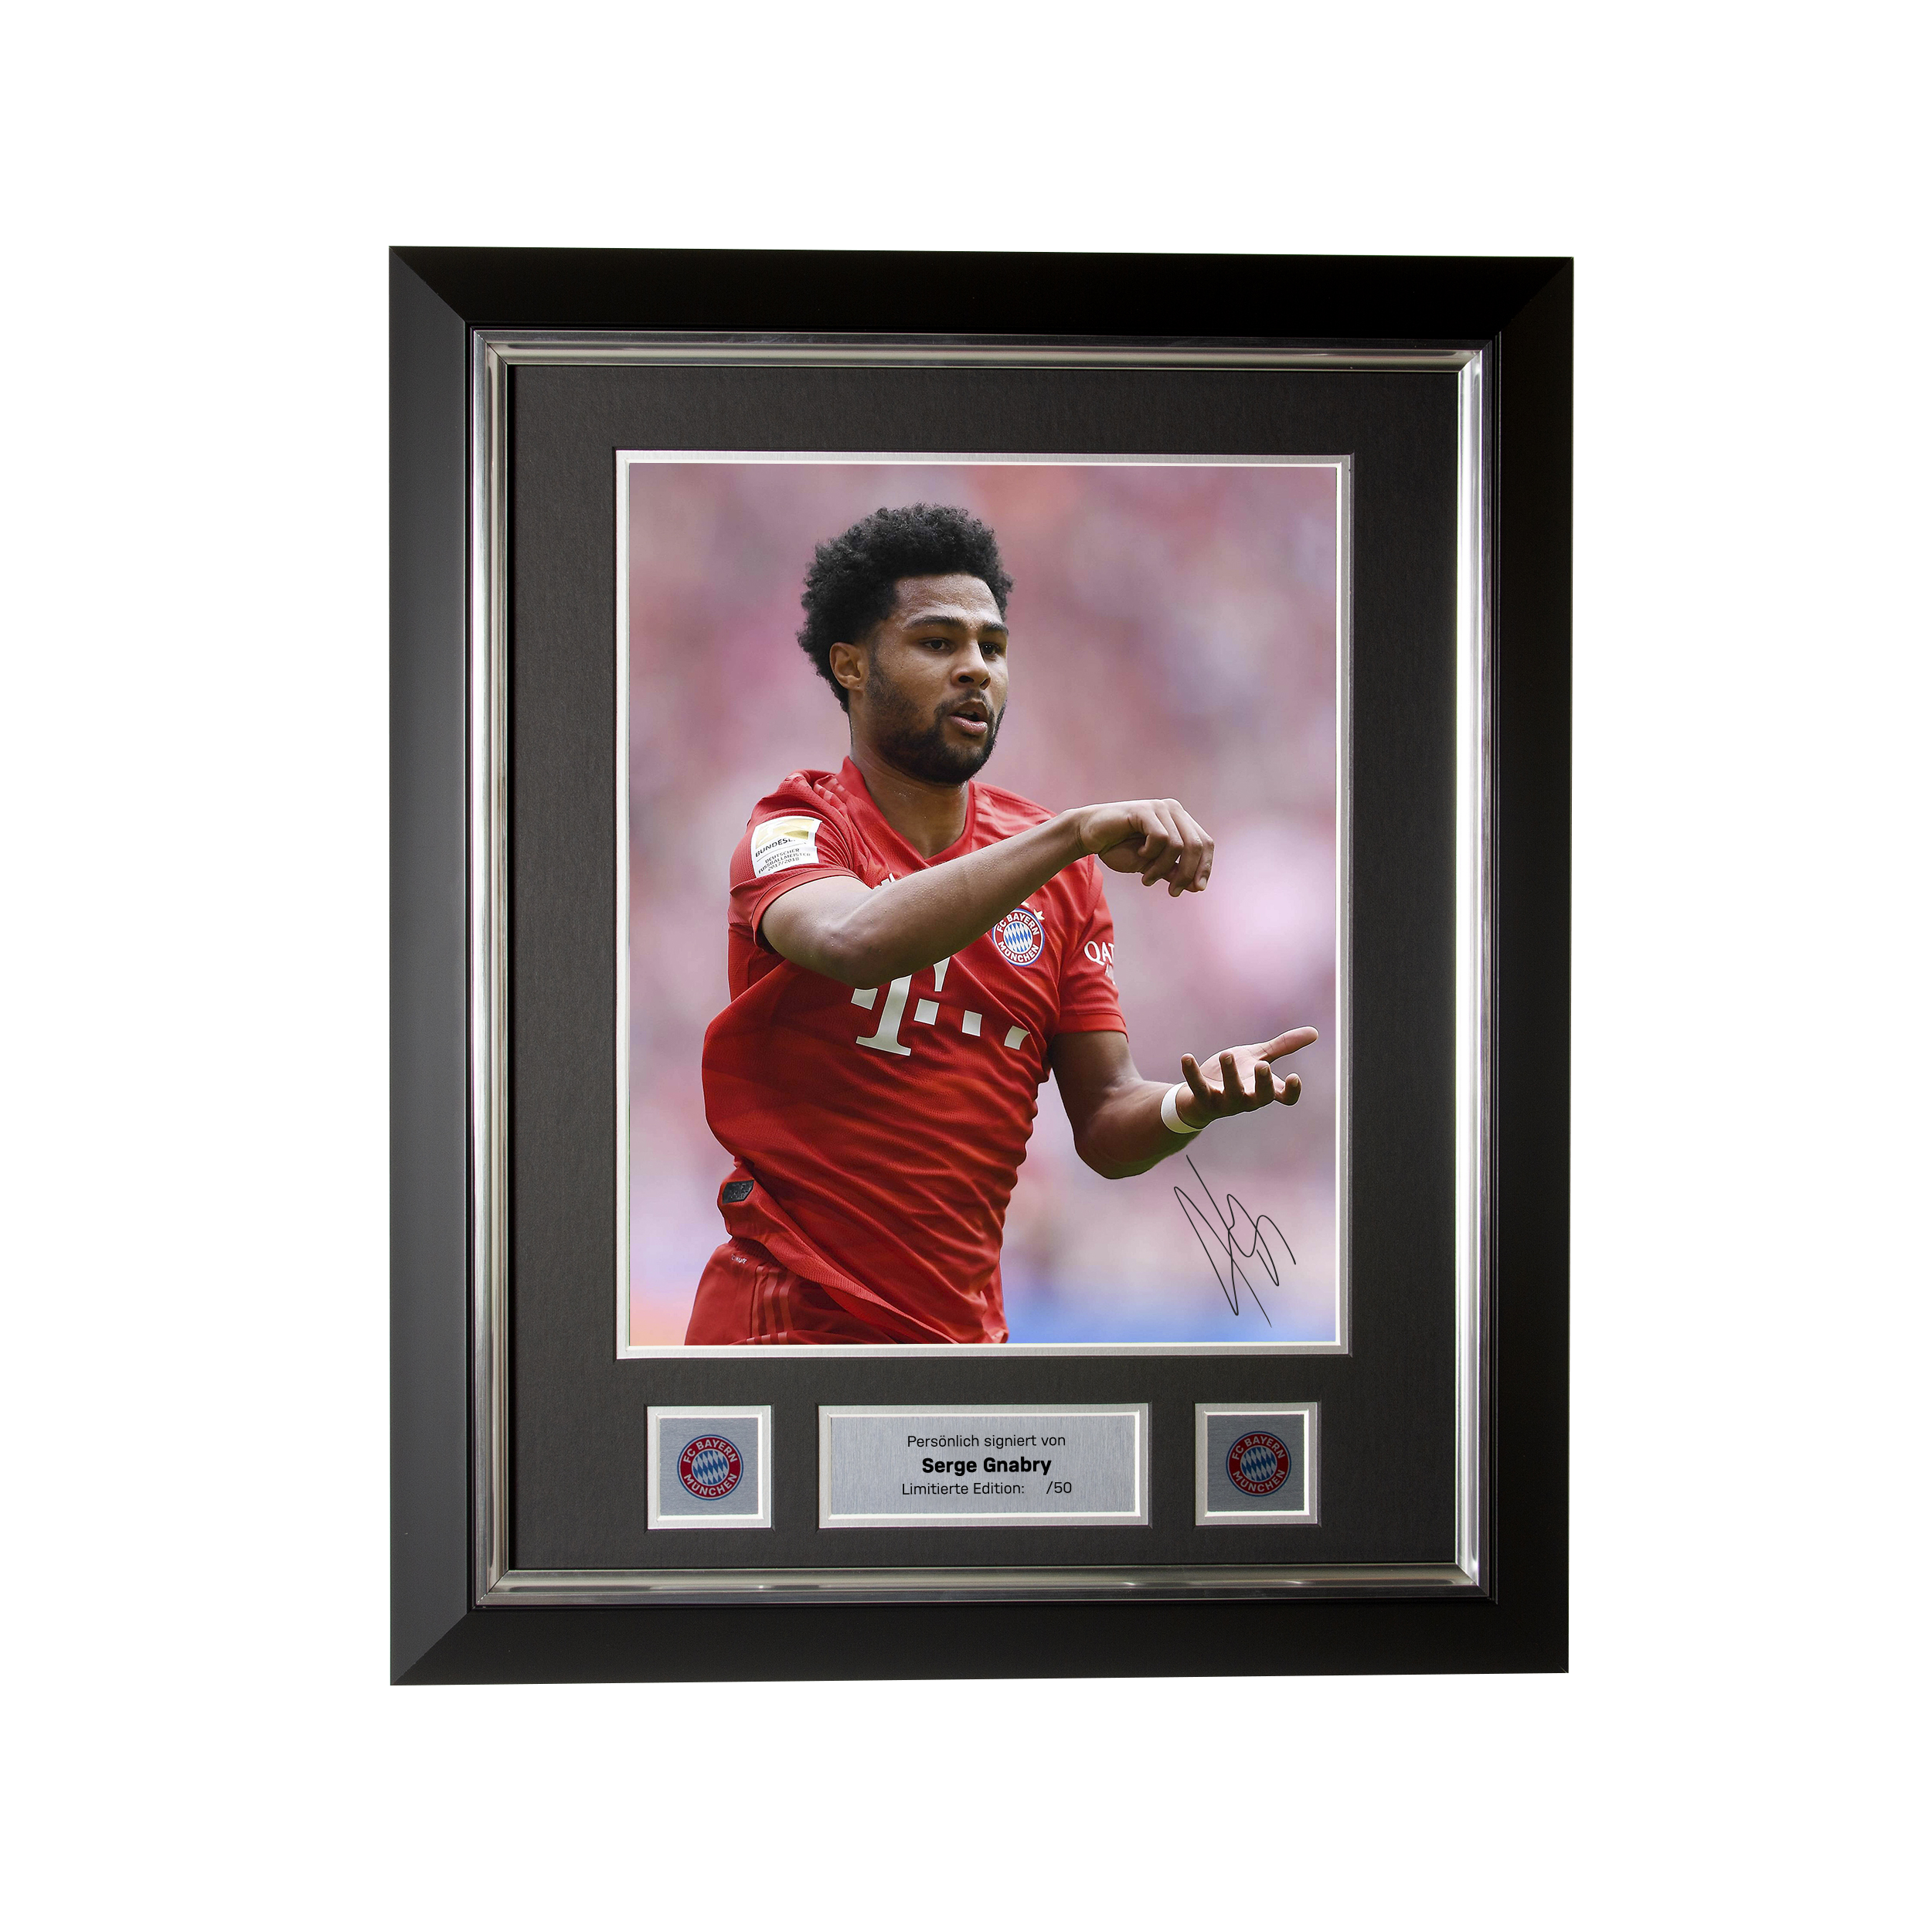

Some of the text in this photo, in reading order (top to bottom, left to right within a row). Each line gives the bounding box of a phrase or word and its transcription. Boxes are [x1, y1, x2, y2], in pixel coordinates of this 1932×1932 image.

[764, 848, 800, 864] DEUTSCHER
[996, 913, 1040, 936] FC BAYERN
[683, 1439, 738, 1464] FC BAYERN
[907, 1434, 1066, 1450] Persönlich signiert von
[1232, 1435, 1286, 1461] FC BAYERN
[922, 1456, 1053, 1477] Serge Gnabry
[683, 1473, 738, 1497] MÜNCHEN
[902, 1481, 1072, 1495] Limitierte Edition: /50
[1233, 1469, 1286, 1493] MÜNCHEN
